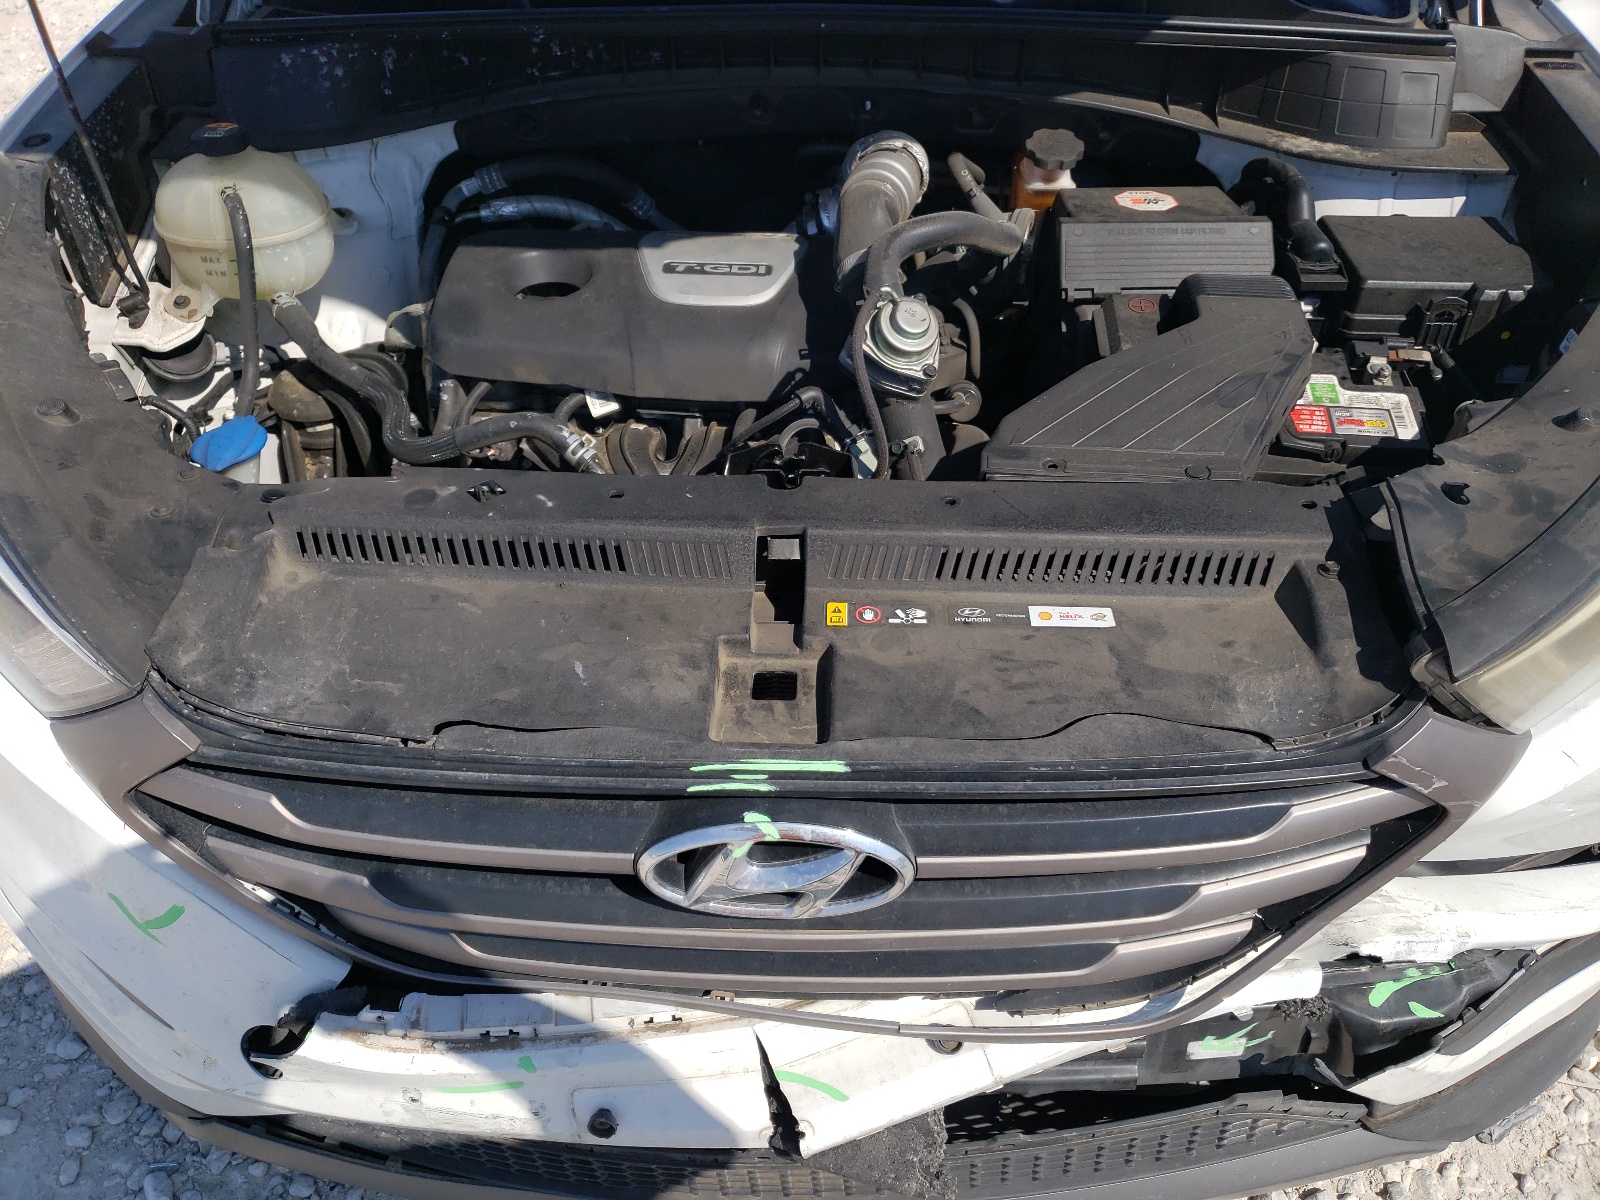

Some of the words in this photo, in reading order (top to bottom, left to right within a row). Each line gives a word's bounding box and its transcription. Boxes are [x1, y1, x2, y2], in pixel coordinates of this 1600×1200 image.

[1128, 228, 1143, 236] OUT
[1146, 228, 1156, 236] TO
[1156, 228, 1179, 236] OPEN
[200, 256, 221, 264] MAX
[205, 269, 227, 277] MIN
